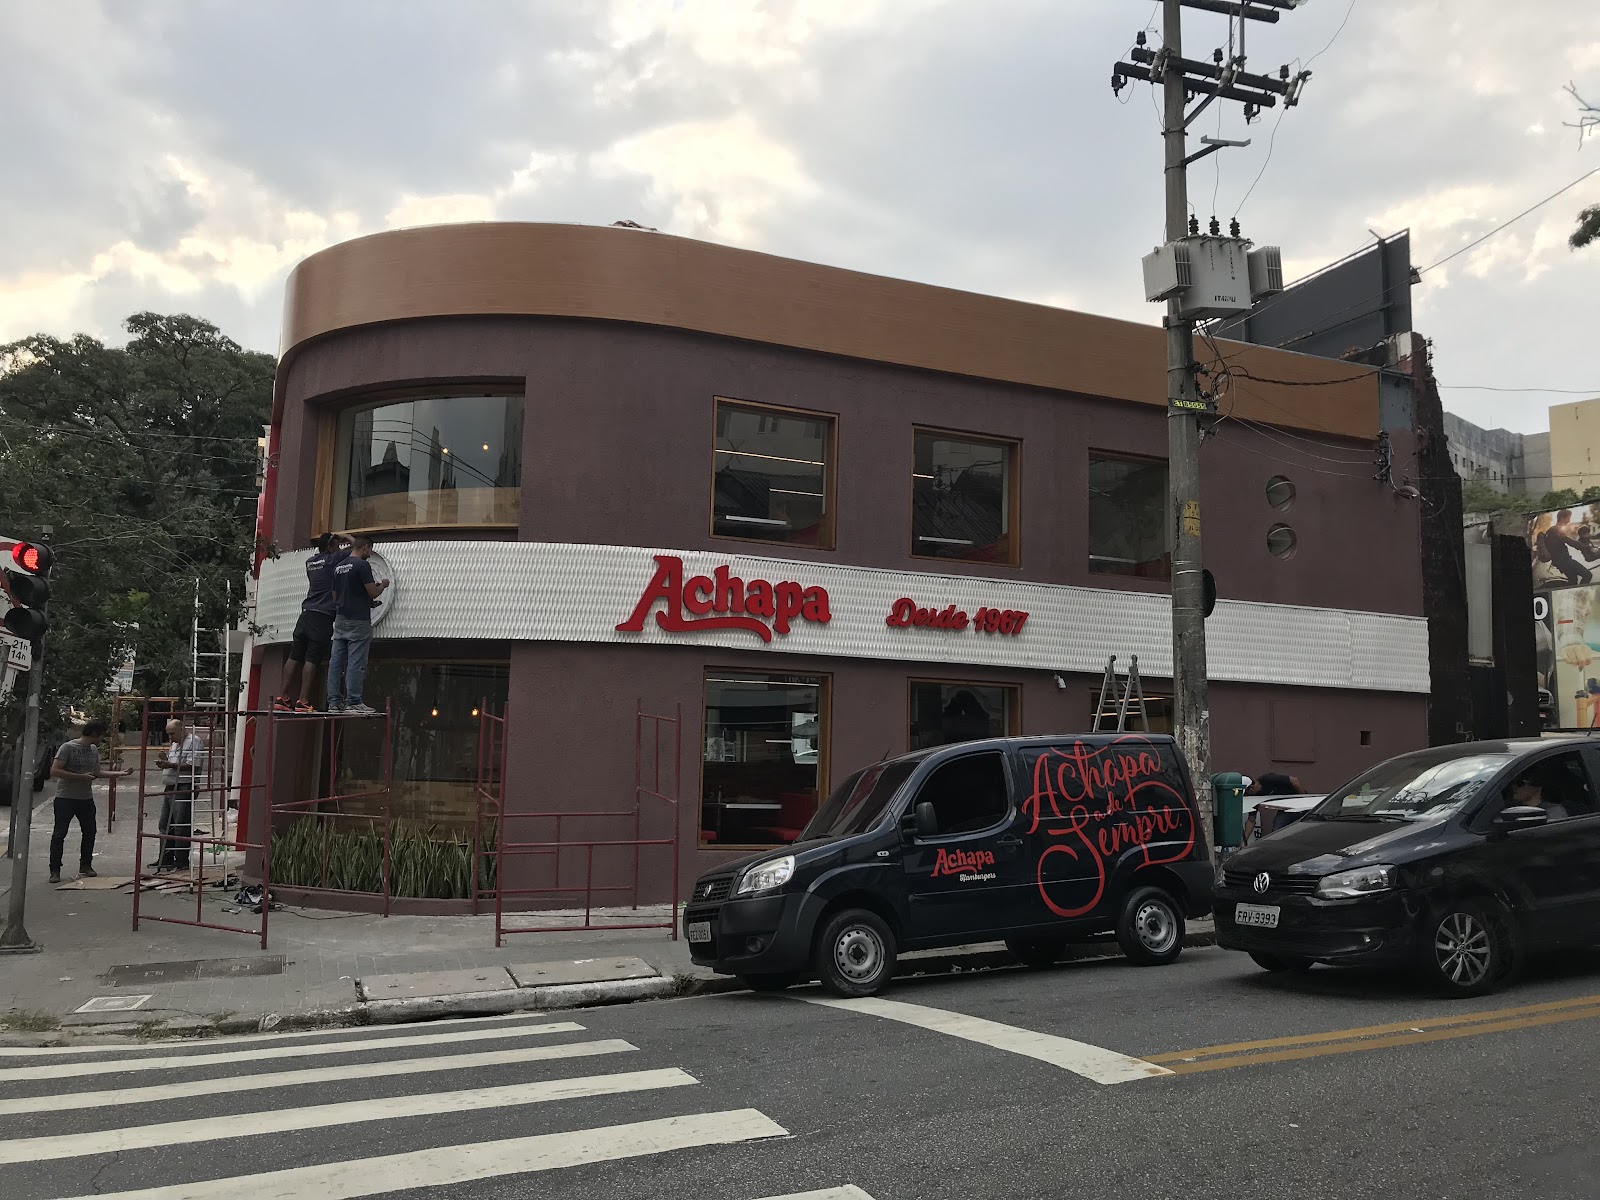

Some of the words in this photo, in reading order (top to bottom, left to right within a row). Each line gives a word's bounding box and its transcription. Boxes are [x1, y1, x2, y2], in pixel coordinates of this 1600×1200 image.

[615, 555, 832, 643] Achapa
[886, 598, 969, 631] Desde
[973, 606, 1029, 636] 1967
[930, 848, 995, 877] Achapa
[959, 872, 996, 883] Hamburgers
